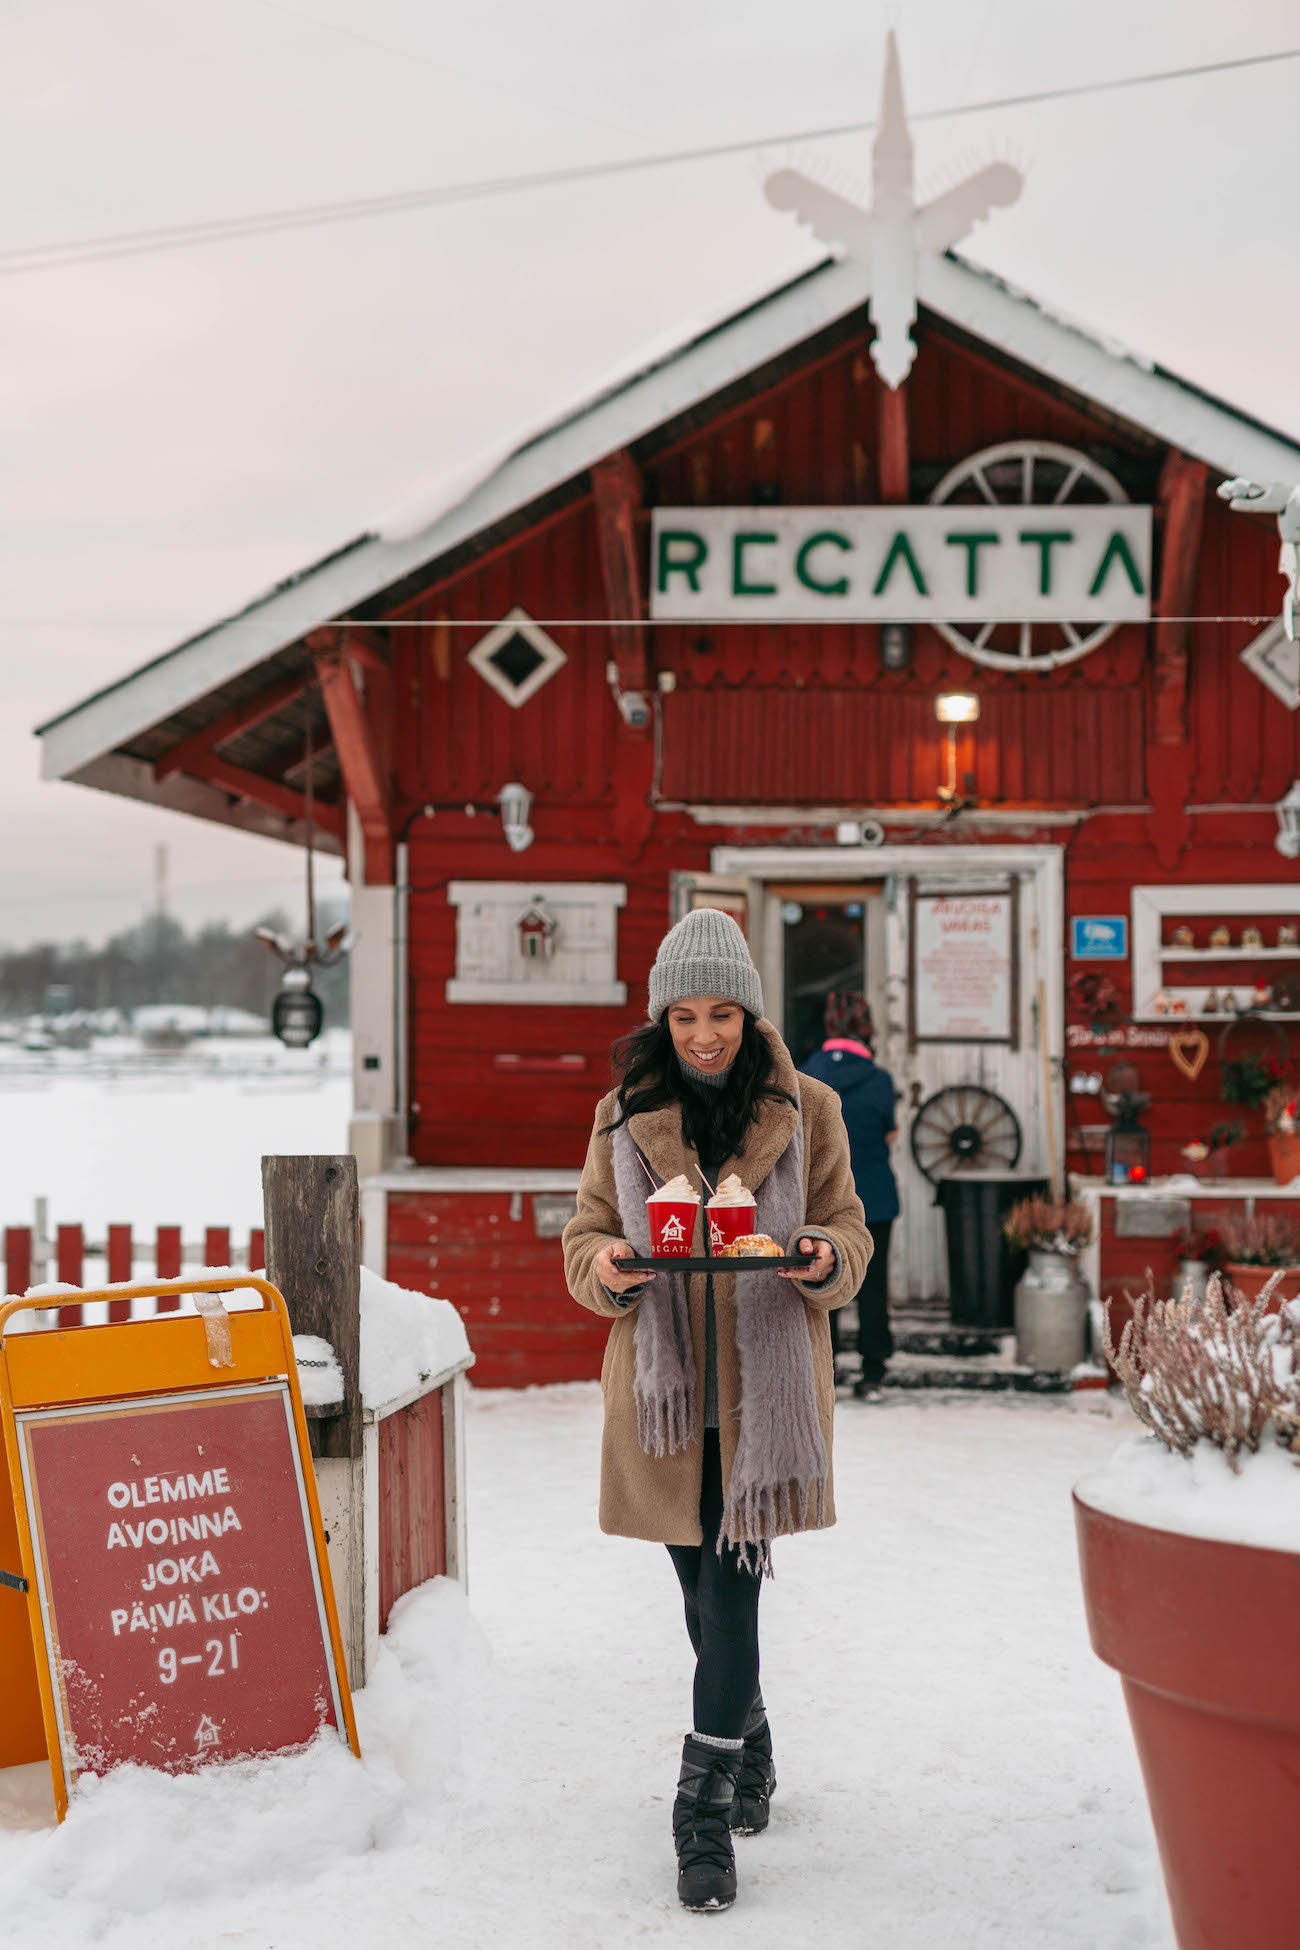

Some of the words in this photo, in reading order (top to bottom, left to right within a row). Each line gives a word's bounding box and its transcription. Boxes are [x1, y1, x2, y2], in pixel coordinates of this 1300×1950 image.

[657, 531, 1145, 597] REGATTA
[107, 1467, 231, 1509] OLEMME
[107, 1506, 242, 1550] AVOINNA
[141, 1550, 221, 1591] JOKA
[111, 1593, 198, 1636] PÄIVÄ
[202, 1587, 269, 1622] KLO:
